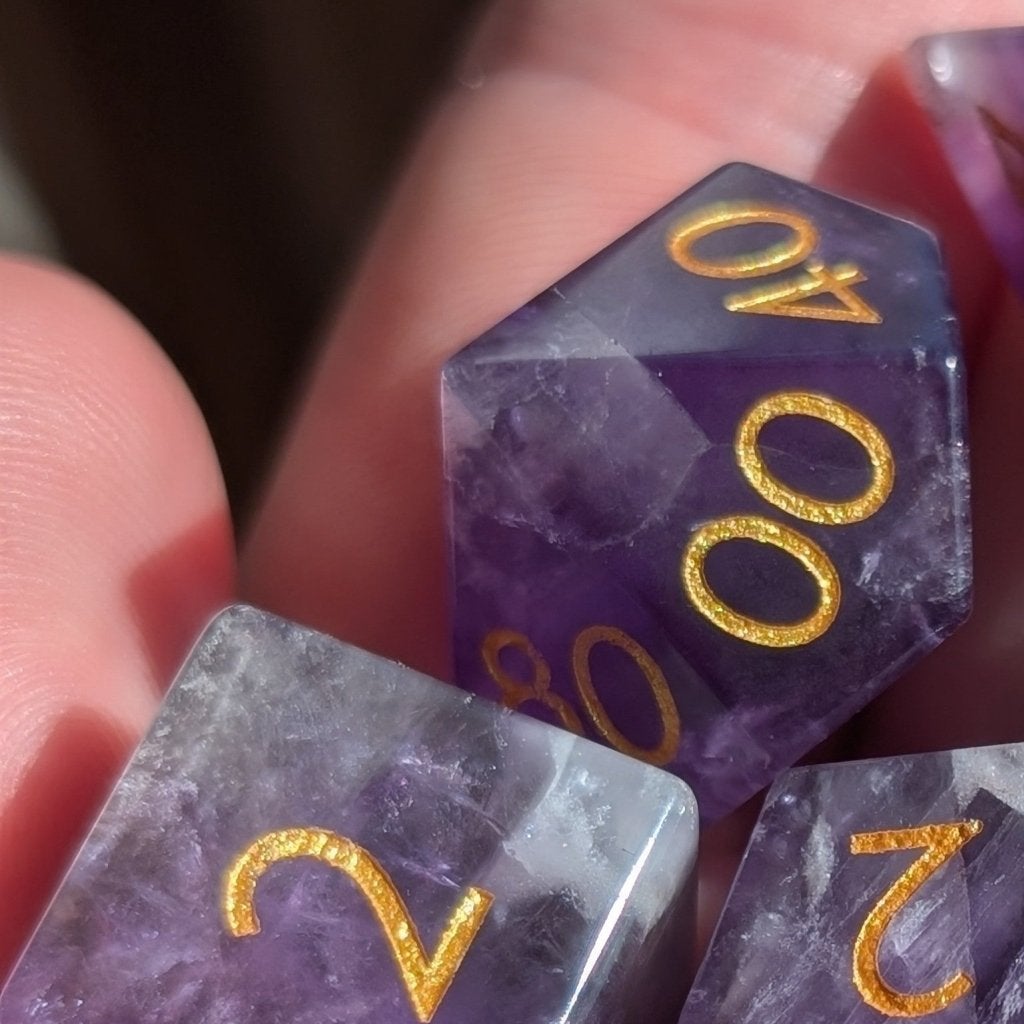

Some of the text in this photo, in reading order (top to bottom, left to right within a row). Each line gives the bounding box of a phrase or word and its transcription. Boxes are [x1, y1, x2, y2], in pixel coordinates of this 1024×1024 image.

[667, 204, 883, 324] 40
[682, 391, 895, 649] 00
[222, 825, 496, 1024] 2
[850, 818, 984, 1019] 2
